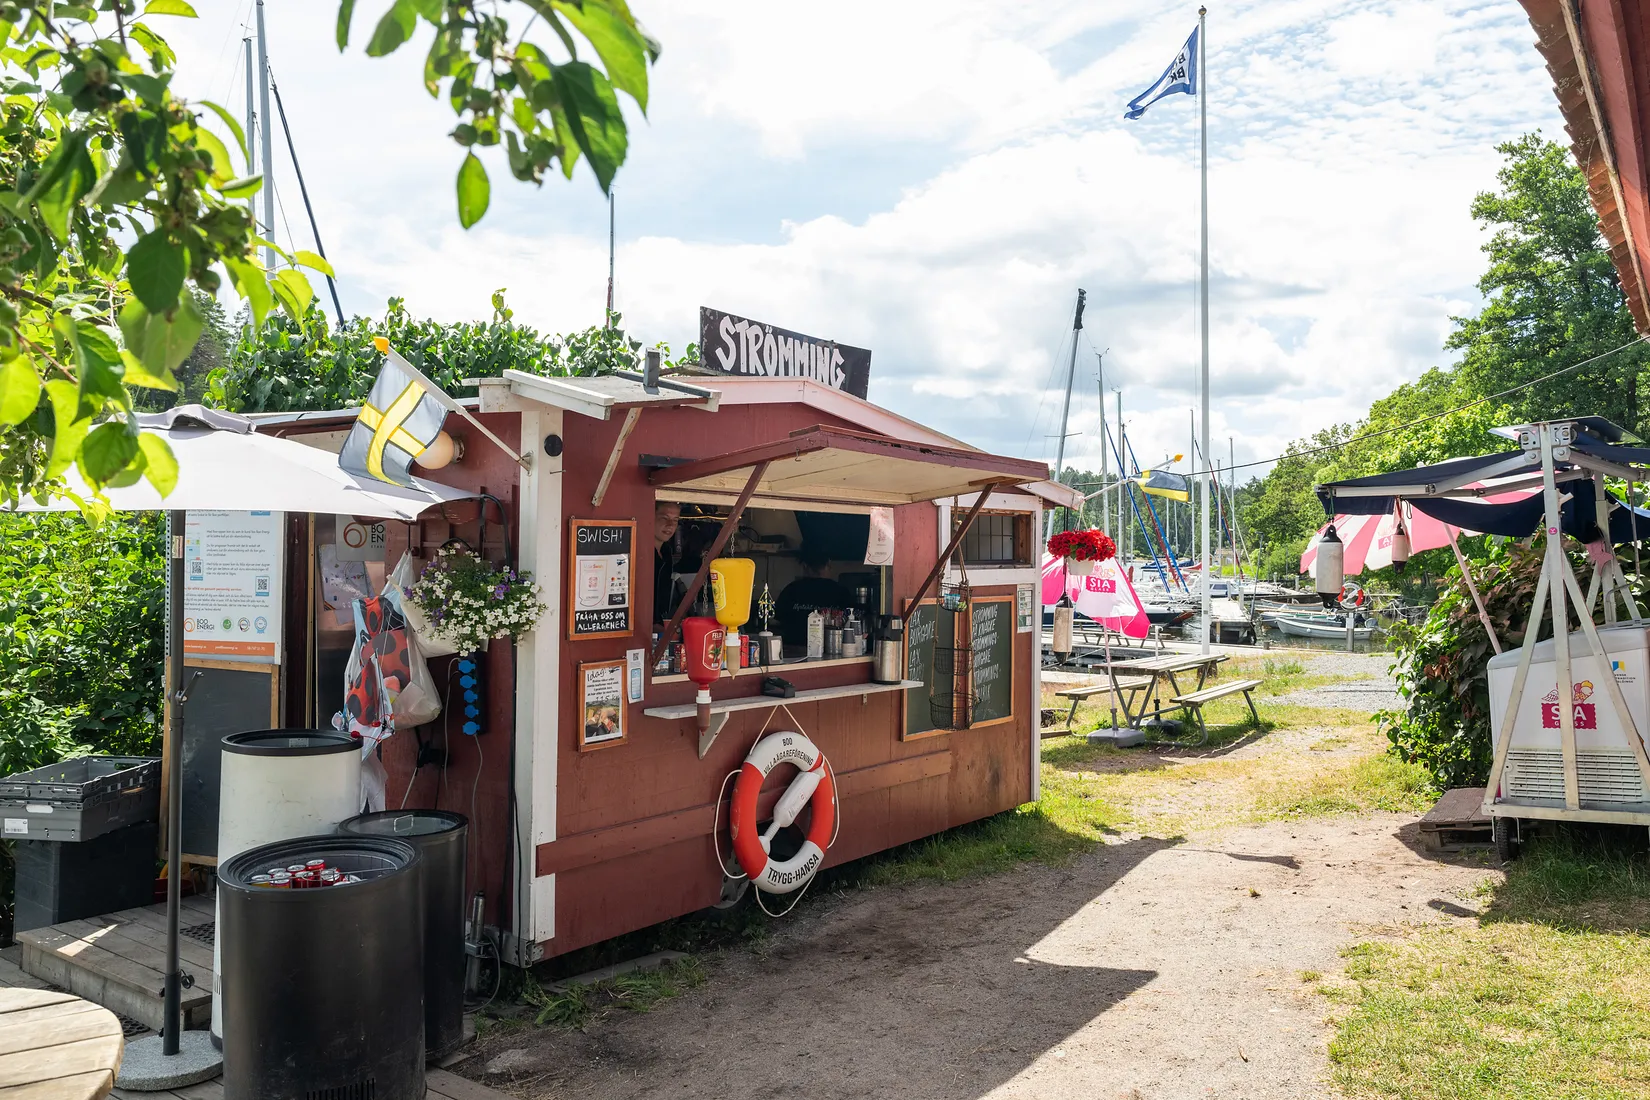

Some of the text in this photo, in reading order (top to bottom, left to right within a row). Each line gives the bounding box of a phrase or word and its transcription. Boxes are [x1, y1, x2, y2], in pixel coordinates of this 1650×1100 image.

[716, 315, 846, 389] STRÖMMING
[577, 528, 623, 544] SWISH!
[1090, 578, 1111, 589] SIA
[576, 611, 626, 622] FRÅGA OSS OM
[577, 620, 627, 632] ALLERGENER
[909, 620, 936, 648] BURGARE
[1551, 705, 1587, 721] SA
[782, 737, 793, 747] BOO
[767, 853, 820, 885] TRYGG-HANSA
